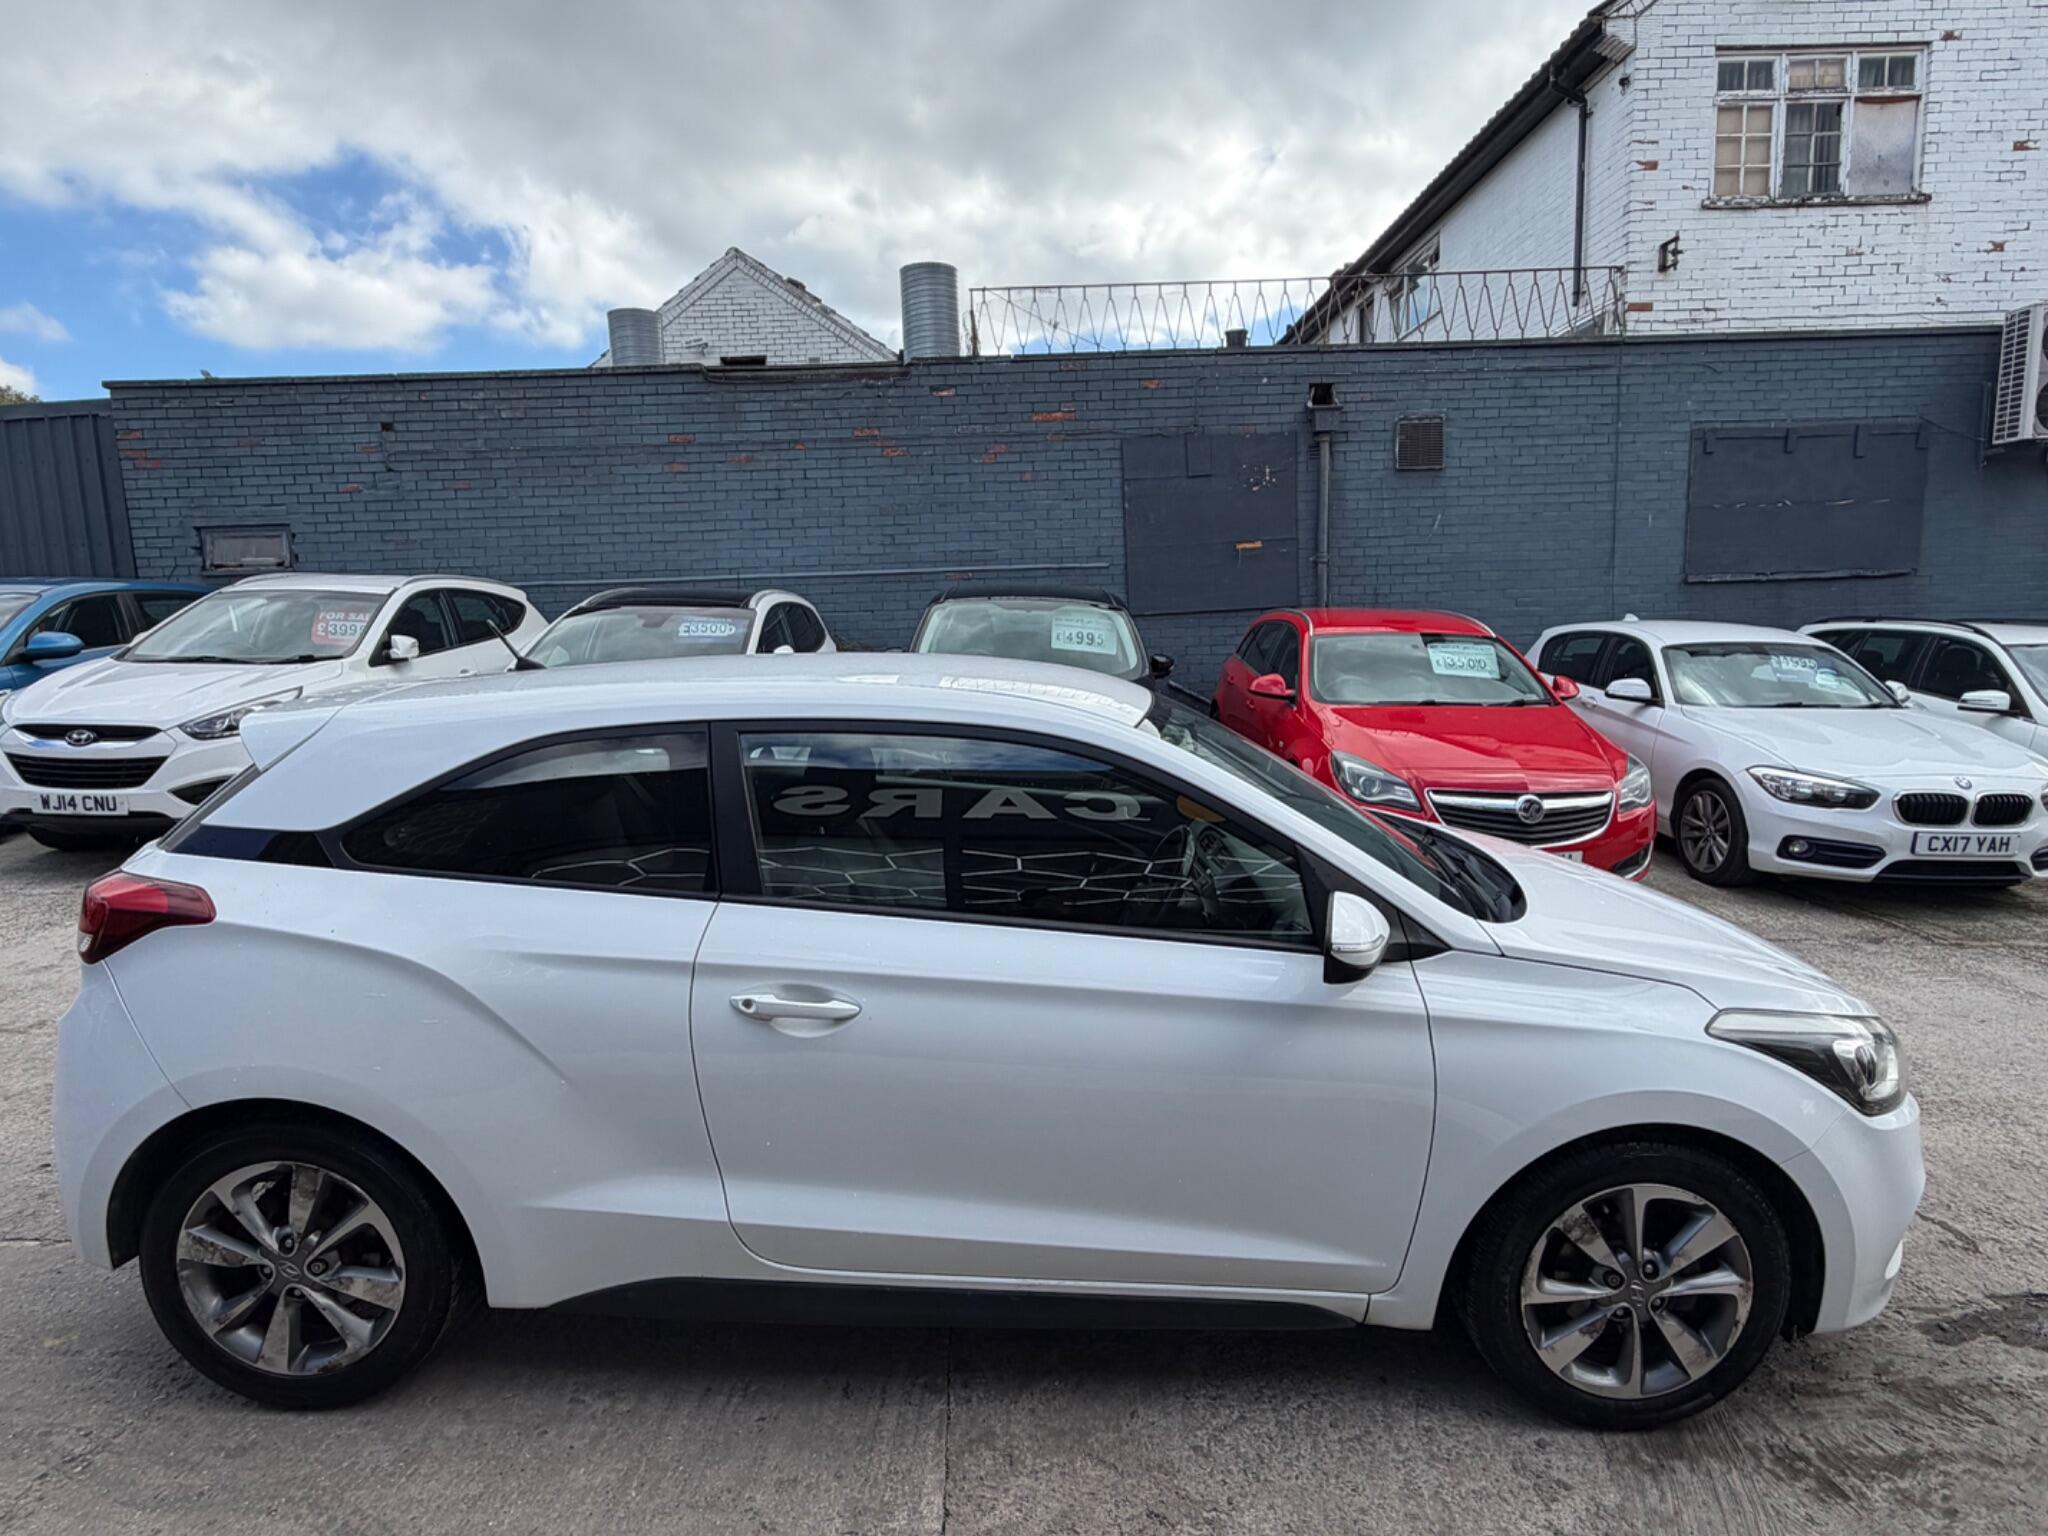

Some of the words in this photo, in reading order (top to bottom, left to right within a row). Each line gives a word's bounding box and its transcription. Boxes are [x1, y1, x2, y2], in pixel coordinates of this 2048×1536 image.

[320, 611, 345, 620] FOR
[40, 794, 77, 811] WJ14
[82, 795, 117, 812] CNU
[1927, 836, 1971, 852] CX17
[1976, 836, 2011, 853] YAH
